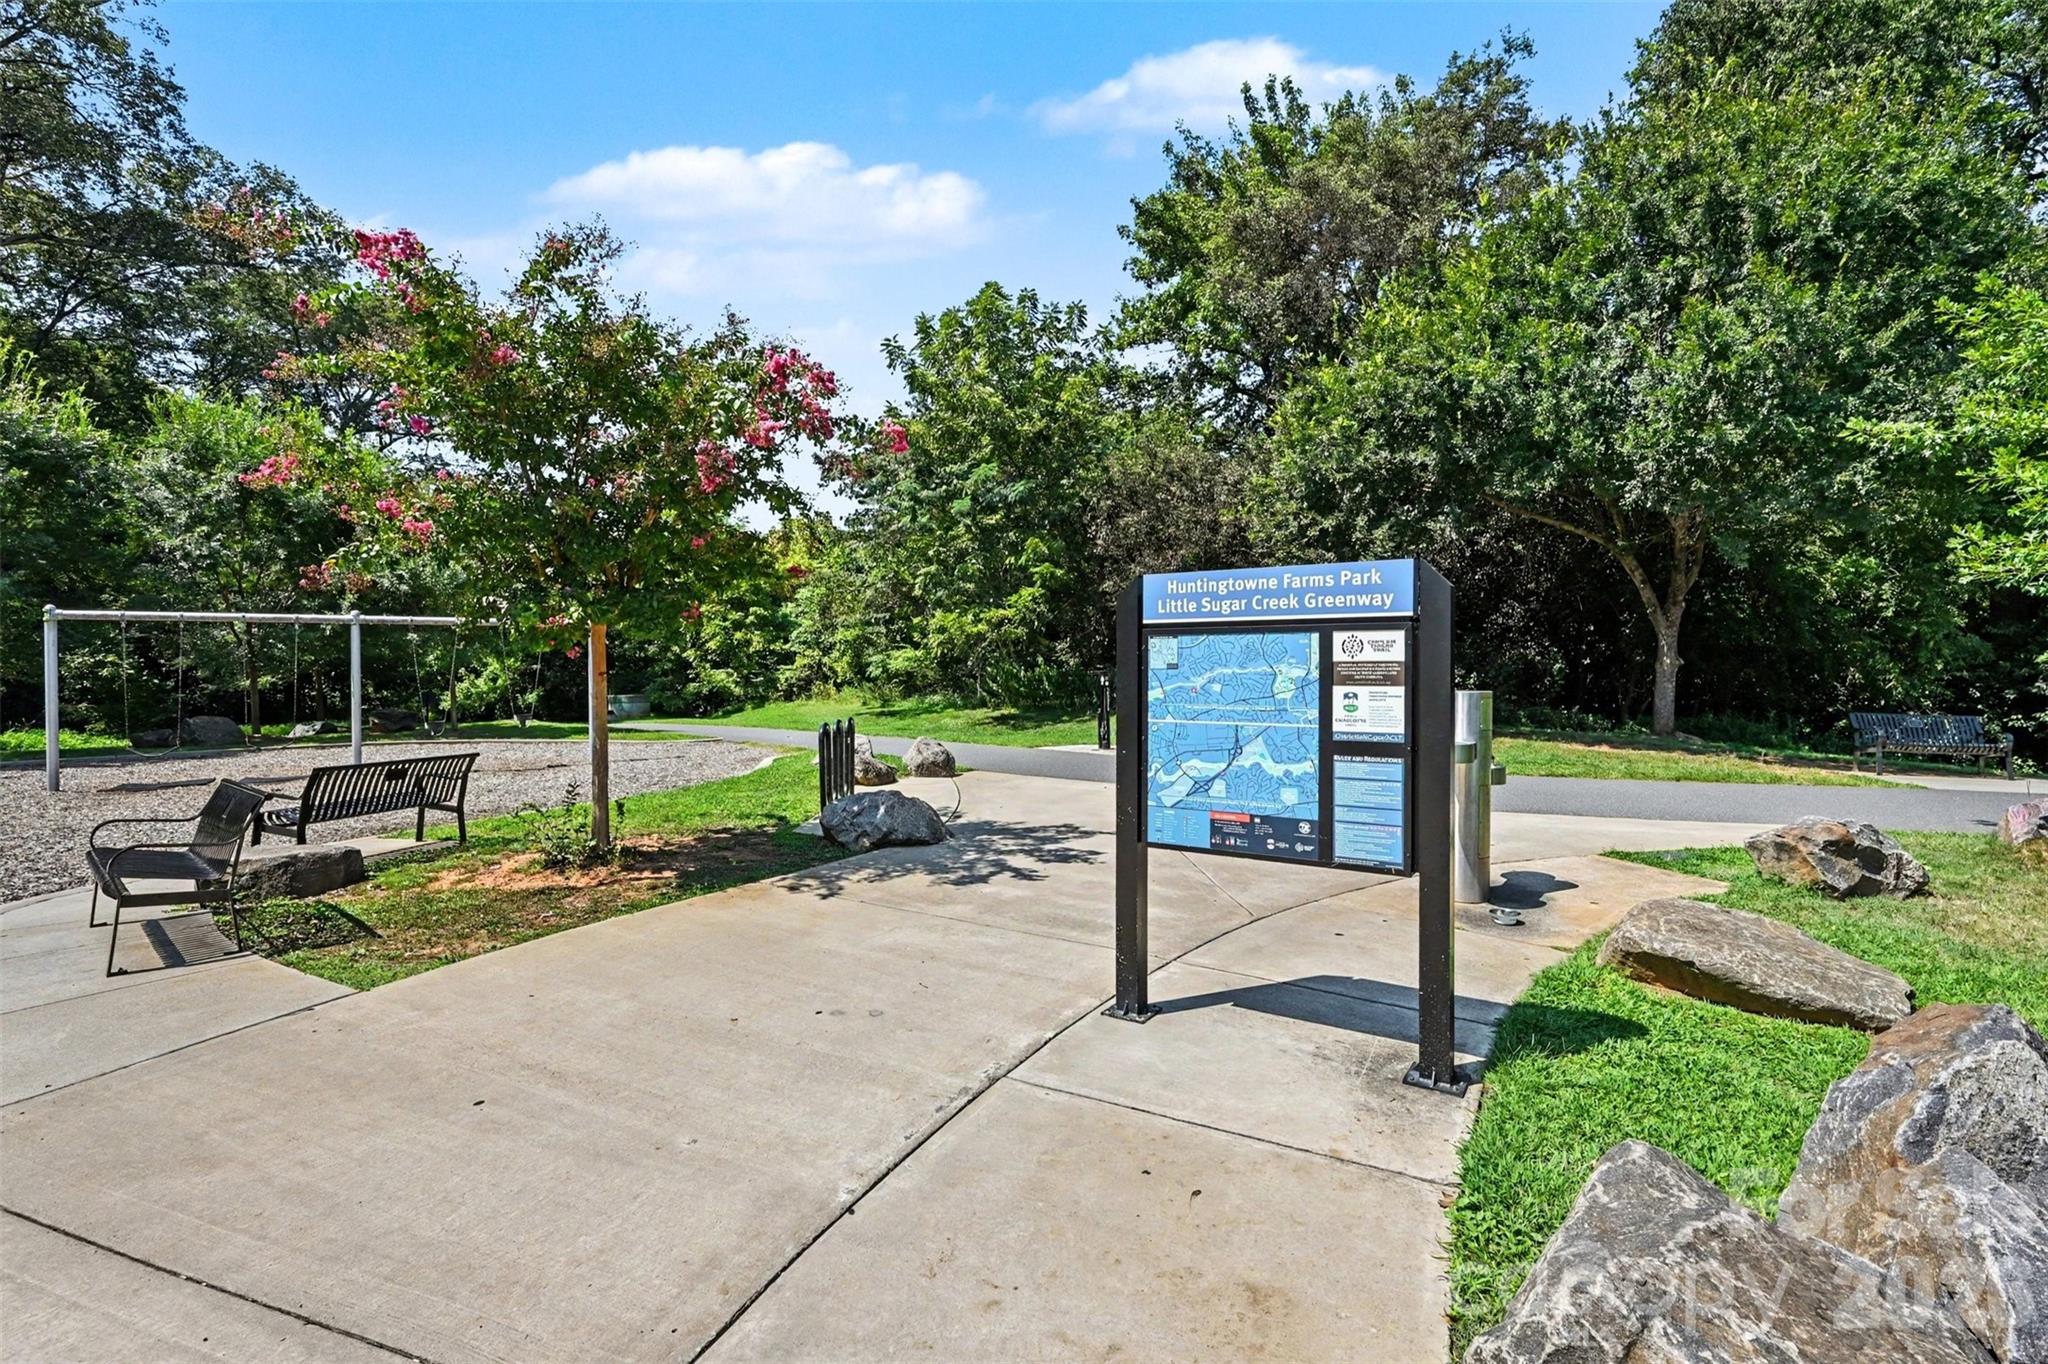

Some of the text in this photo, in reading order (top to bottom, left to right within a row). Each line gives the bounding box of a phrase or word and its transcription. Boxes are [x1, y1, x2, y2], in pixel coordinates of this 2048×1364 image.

[1167, 568, 1382, 595] Huntingtowne Farms Park
[1157, 591, 1394, 615] Little Sugar Creek Greenway
